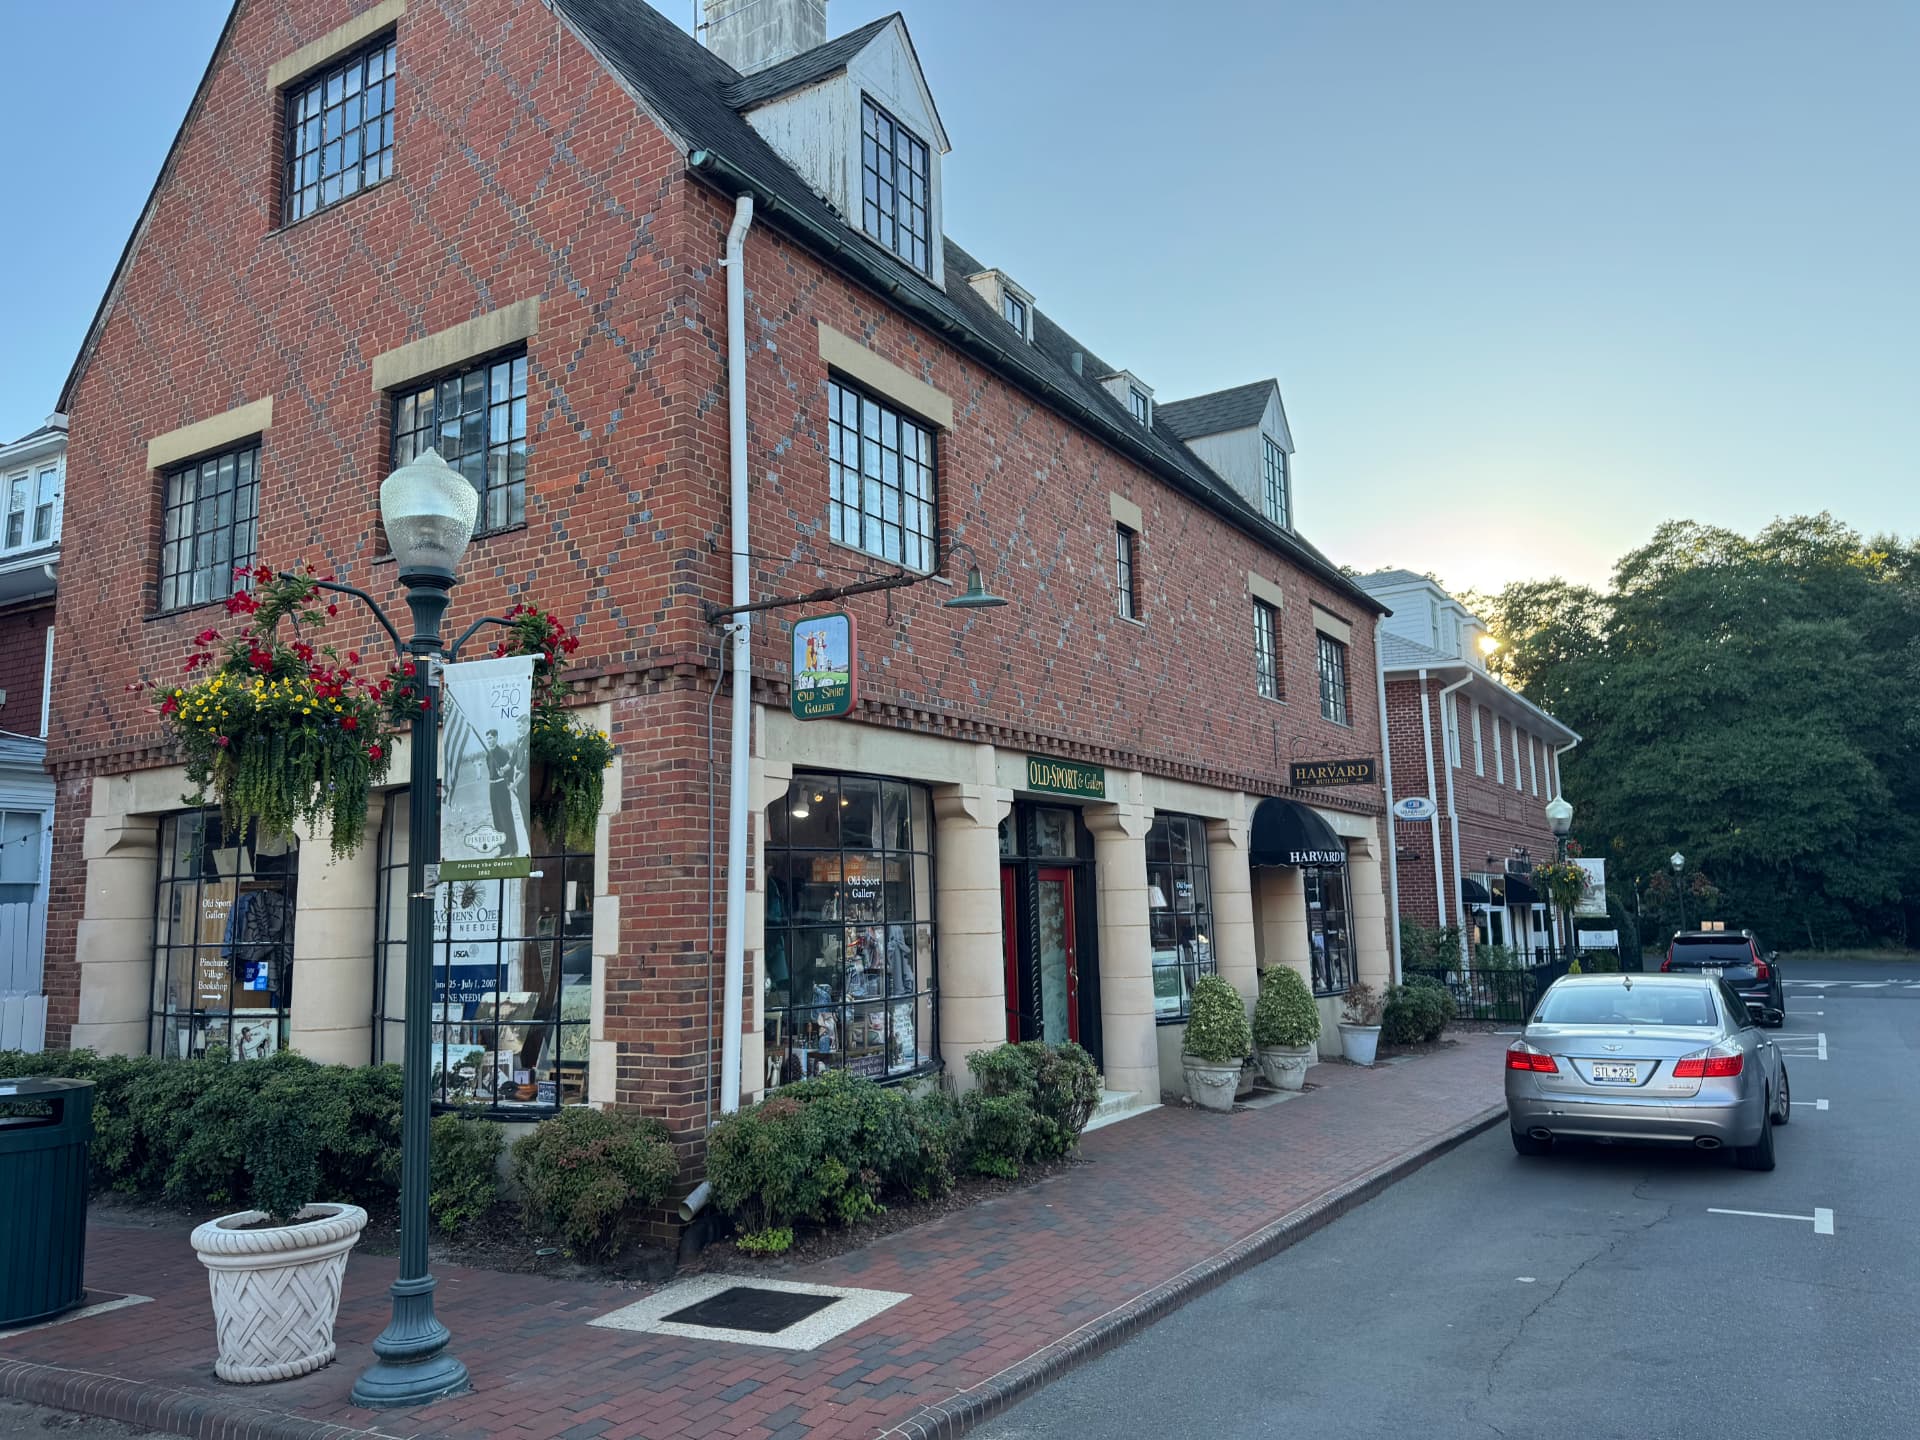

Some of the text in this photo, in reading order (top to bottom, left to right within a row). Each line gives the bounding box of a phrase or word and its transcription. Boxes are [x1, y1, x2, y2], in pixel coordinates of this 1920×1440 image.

[491, 688, 521, 708] 250
[797, 687, 845, 702] OLD SPORT
[500, 706, 519, 719] NC
[804, 702, 836, 714] GALLERY
[1295, 764, 1369, 779] HARVARD
[1078, 773, 1083, 787] &
[1290, 850, 1340, 863] HARVARD
[847, 875, 880, 887] Old Sport
[852, 888, 876, 899] Gallery
[202, 898, 232, 909] Old Sport
[205, 910, 227, 920] Gallery
[477, 907, 499, 922] OPE
[459, 922, 497, 932] NEEDLE
[453, 950, 470, 958] USGA
[203, 970, 224, 980] Village
[461, 979, 473, 991] July
[440, 993, 458, 1002] PNE
